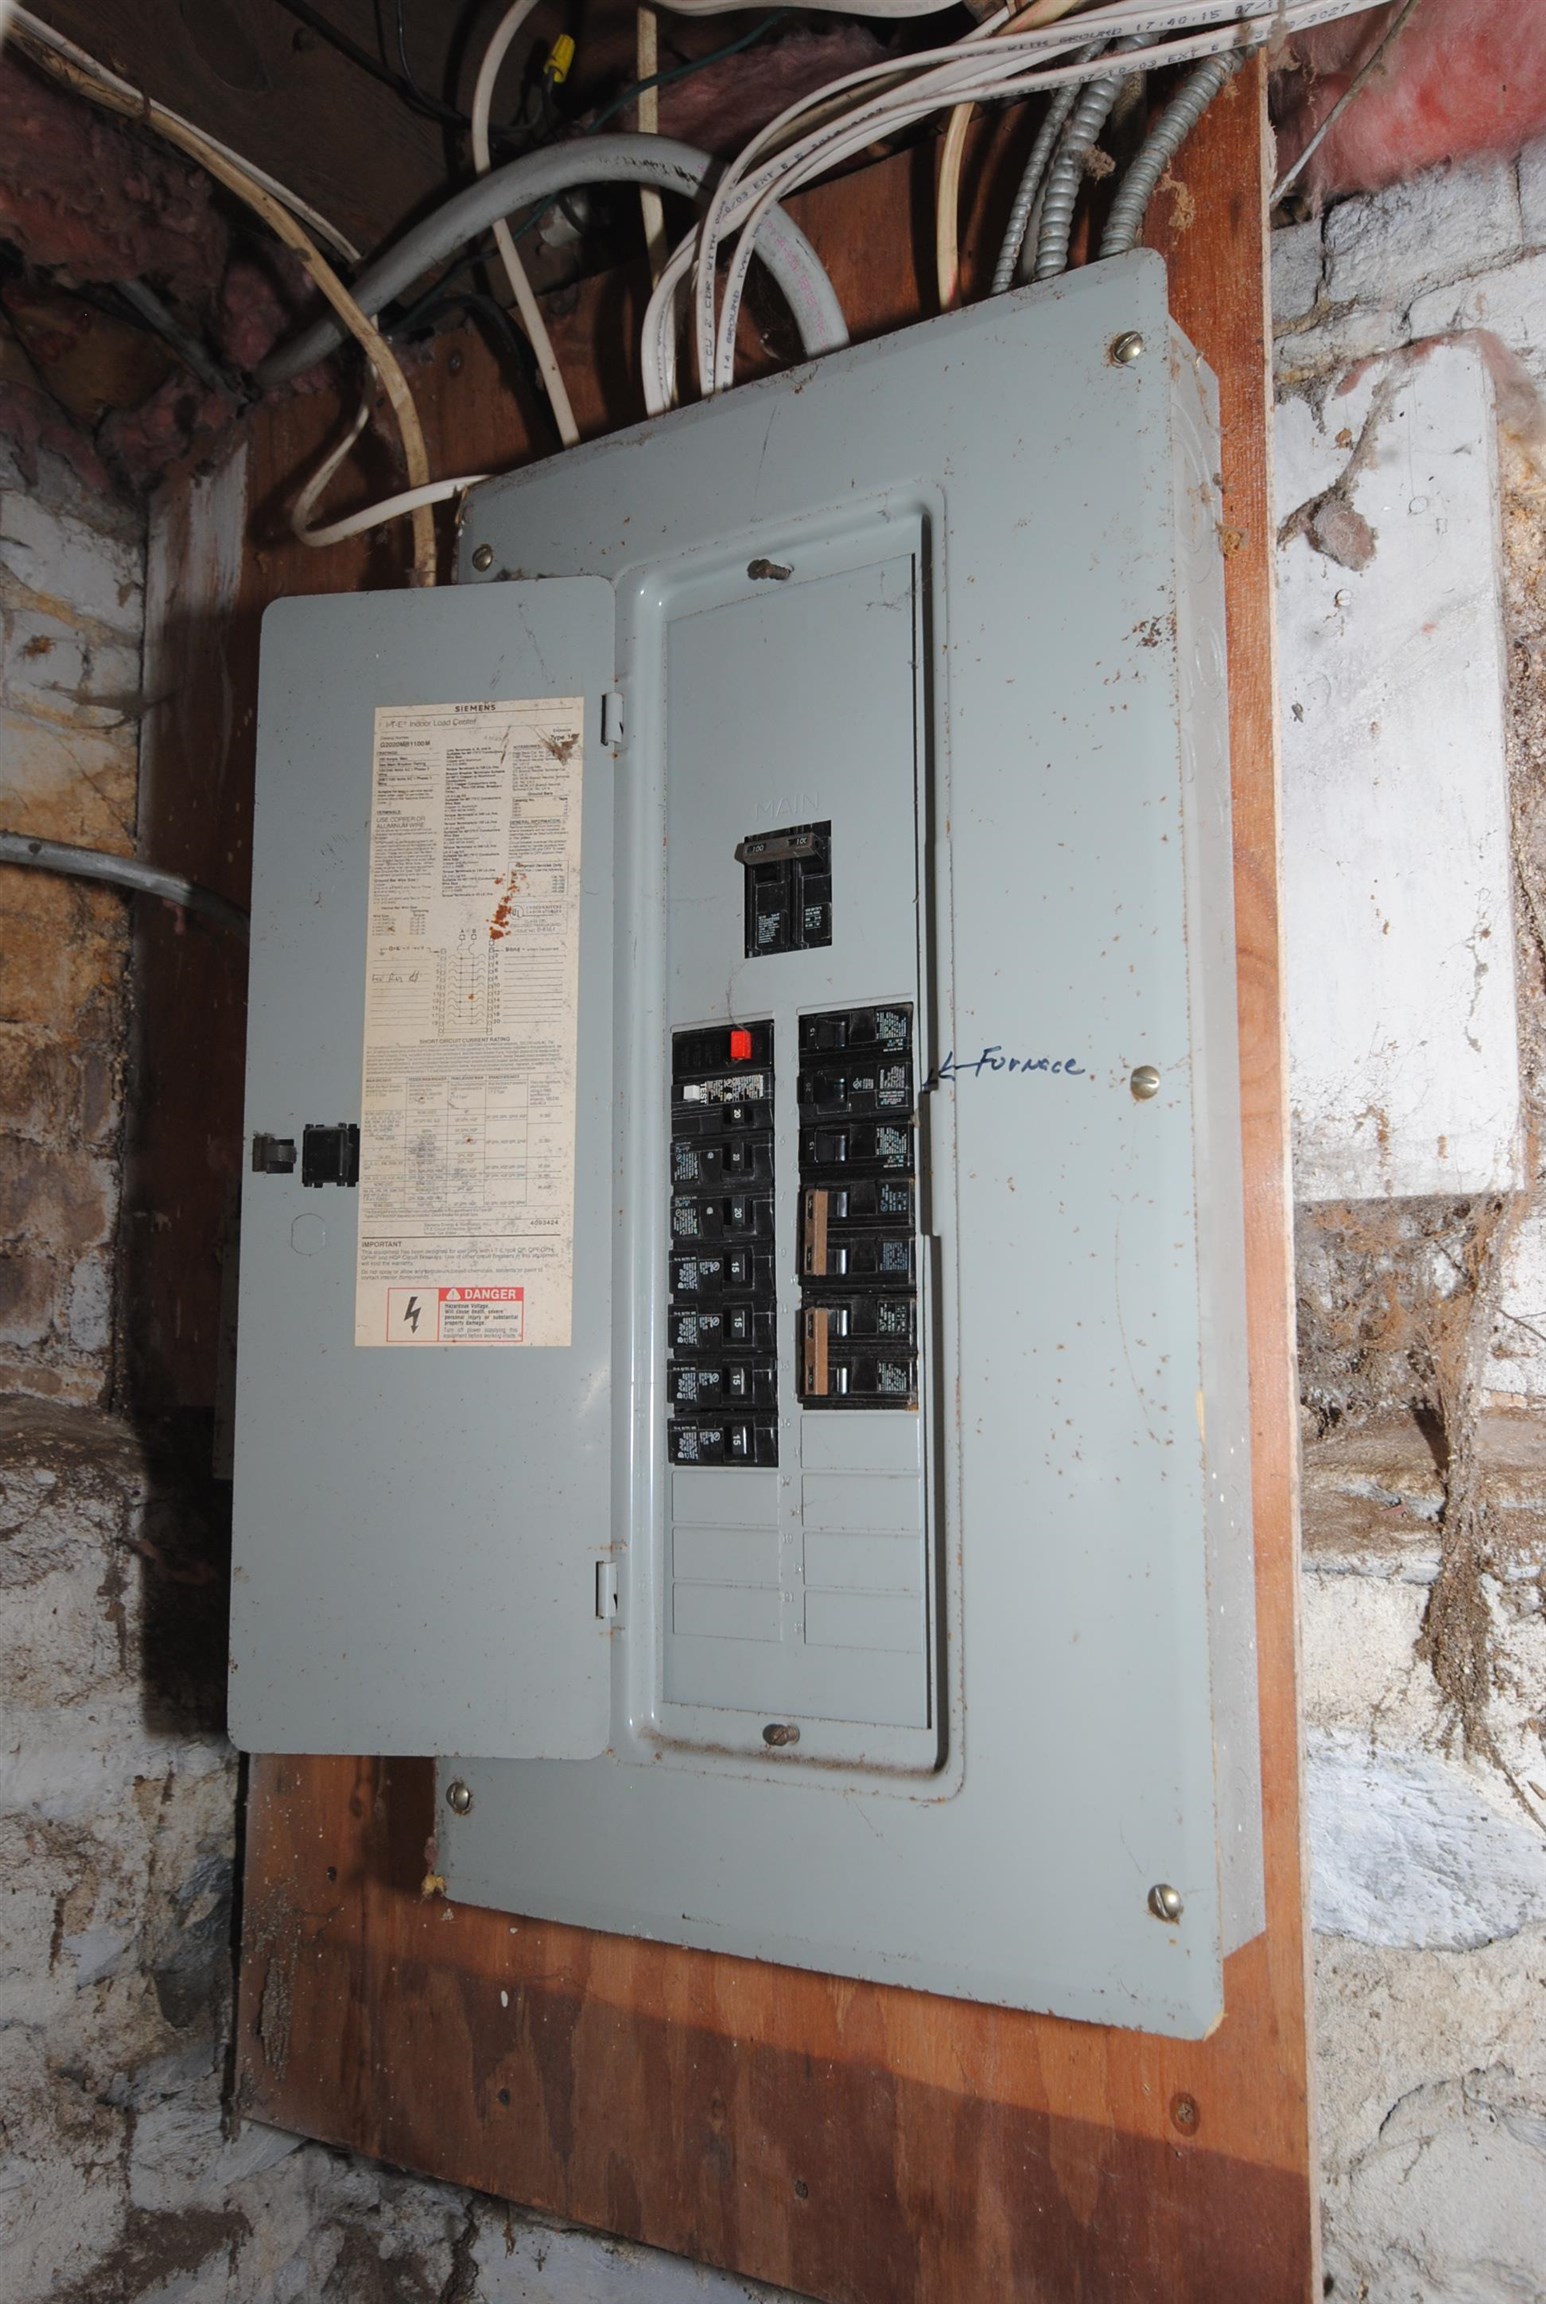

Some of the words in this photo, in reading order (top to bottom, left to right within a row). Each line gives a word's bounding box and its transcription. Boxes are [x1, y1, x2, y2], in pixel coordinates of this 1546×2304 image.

[455, 703, 497, 713] SIEMENS
[433, 719, 451, 727] Load
[753, 791, 820, 822] MAIN
[752, 843, 765, 853] 100
[699, 1081, 708, 1105] TEST
[733, 1108, 742, 1119] 20
[733, 1207, 743, 1219] 20
[731, 1261, 741, 1273] 15
[464, 1288, 517, 1300] DANGER
[734, 1317, 743, 1328] 15
[732, 1374, 741, 1386] 15
[732, 1434, 741, 1446] 15
